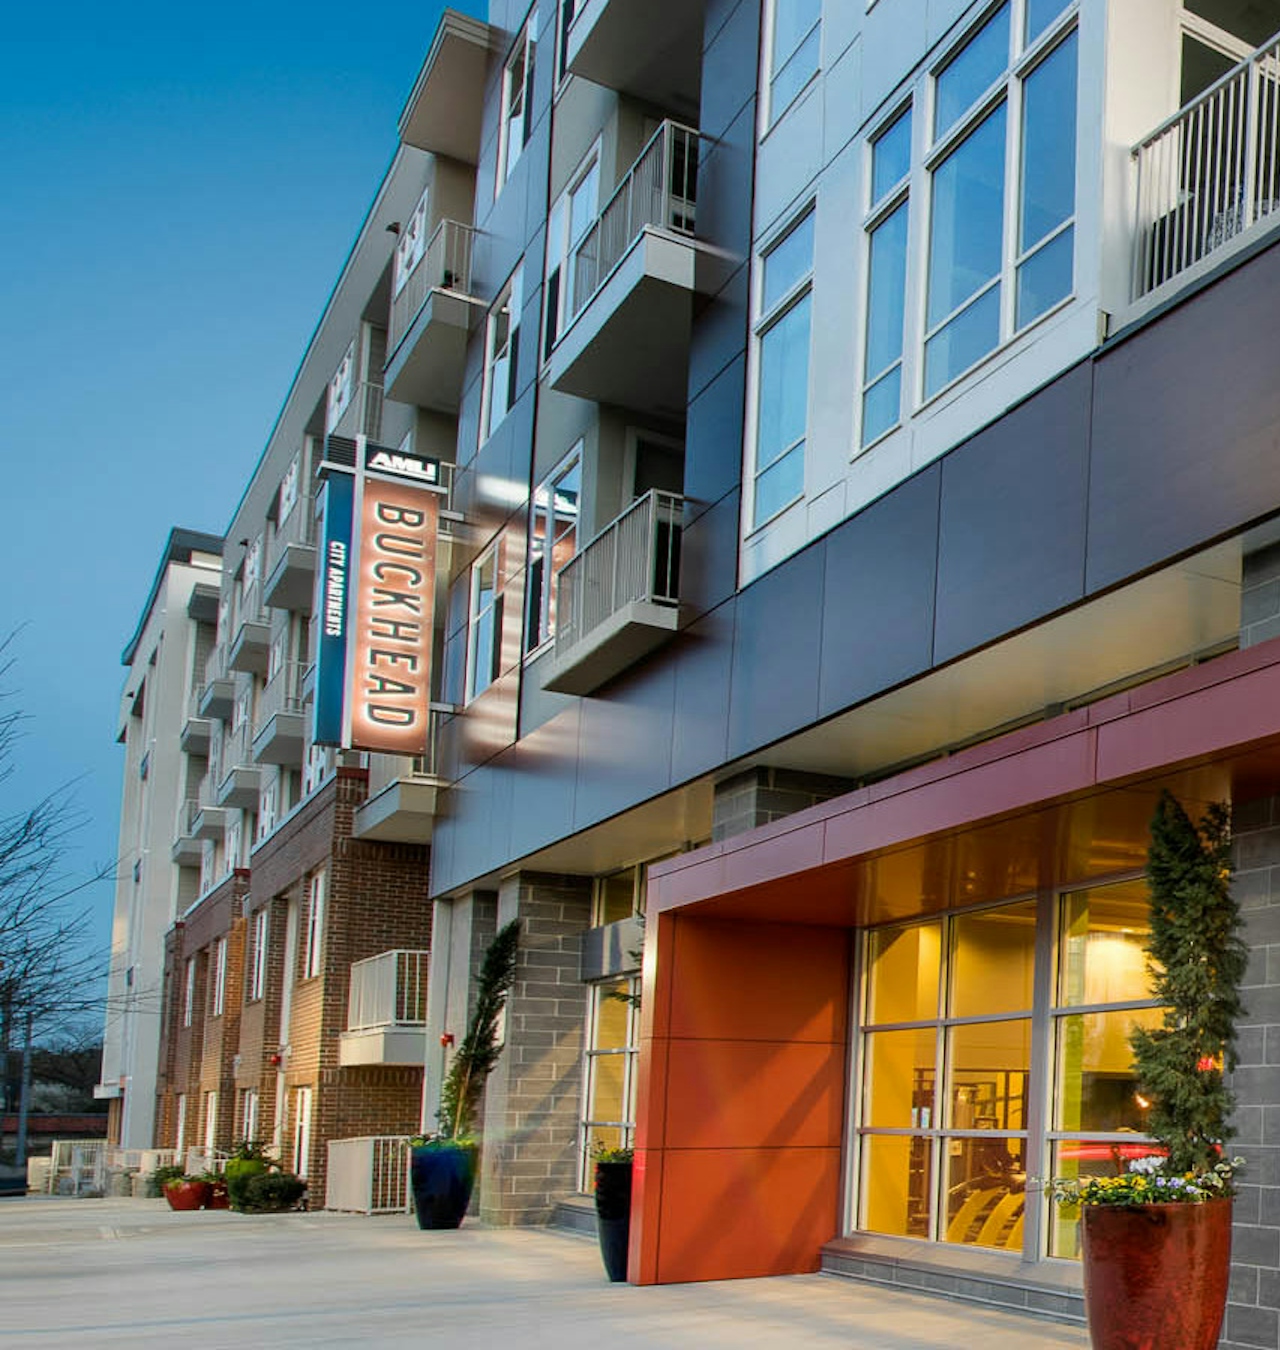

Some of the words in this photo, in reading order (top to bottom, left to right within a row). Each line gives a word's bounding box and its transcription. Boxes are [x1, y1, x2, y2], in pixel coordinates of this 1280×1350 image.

[368, 452, 436, 480] AMLI
[329, 540, 346, 567] CITY
[325, 567, 345, 637] APARTMENTS
[367, 500, 425, 729] BUCKHEAD
